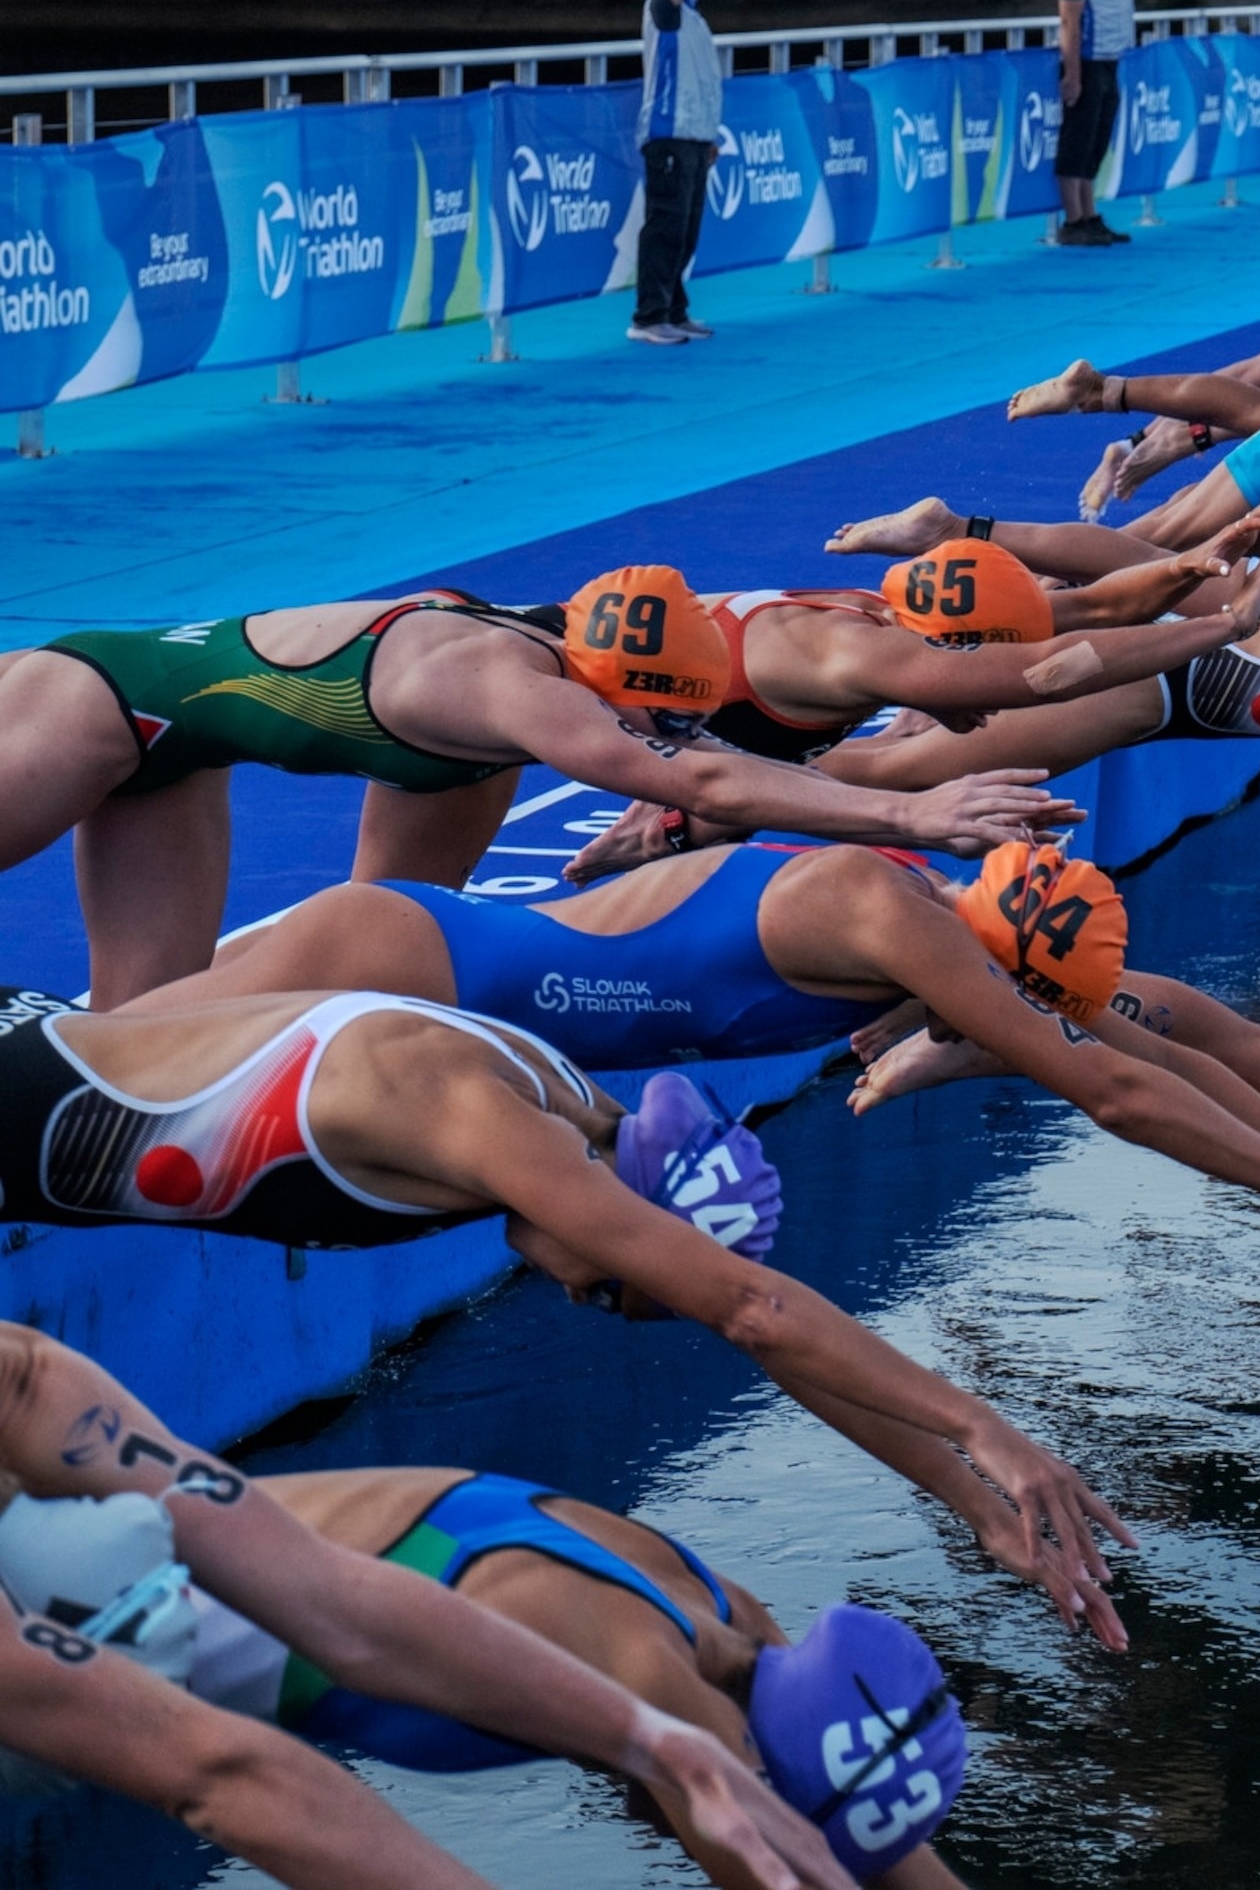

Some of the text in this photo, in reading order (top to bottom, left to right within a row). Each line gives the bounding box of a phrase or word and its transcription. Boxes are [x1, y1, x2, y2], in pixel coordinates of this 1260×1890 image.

[297, 183, 359, 231] World
[0, 228, 56, 280] orld
[298, 231, 384, 279] Triathlon
[0, 279, 90, 334] iathlon
[905, 559, 978, 617] 65
[584, 592, 667, 656] 69
[998, 864, 1094, 962] 64
[571, 976, 651, 996] SLOVAK
[572, 996, 693, 1014] TRIATHLON
[664, 1144, 759, 1248] 54
[119, 1433, 245, 1506] 18
[822, 1707, 943, 1852] 53
